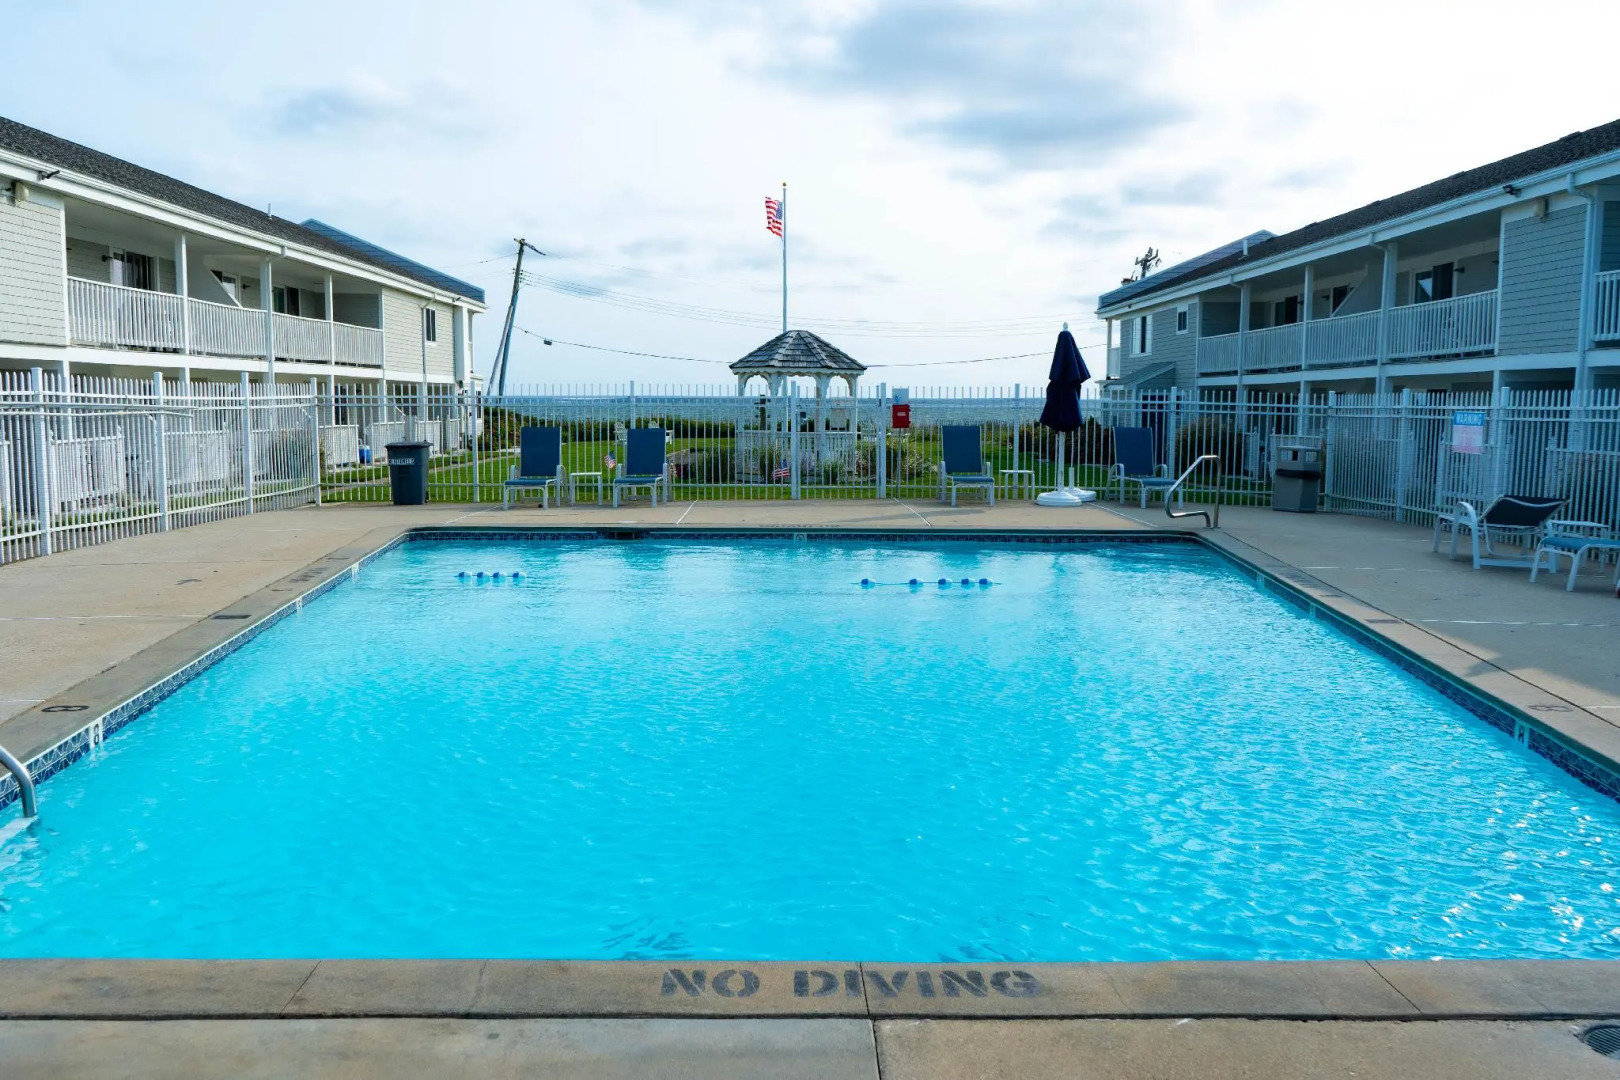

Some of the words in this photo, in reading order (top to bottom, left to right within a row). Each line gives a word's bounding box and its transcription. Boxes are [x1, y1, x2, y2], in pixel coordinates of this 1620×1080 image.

[1456, 413, 1483, 425] WARNING
[660, 968, 761, 998] NO
[793, 969, 1042, 999] DIVING
